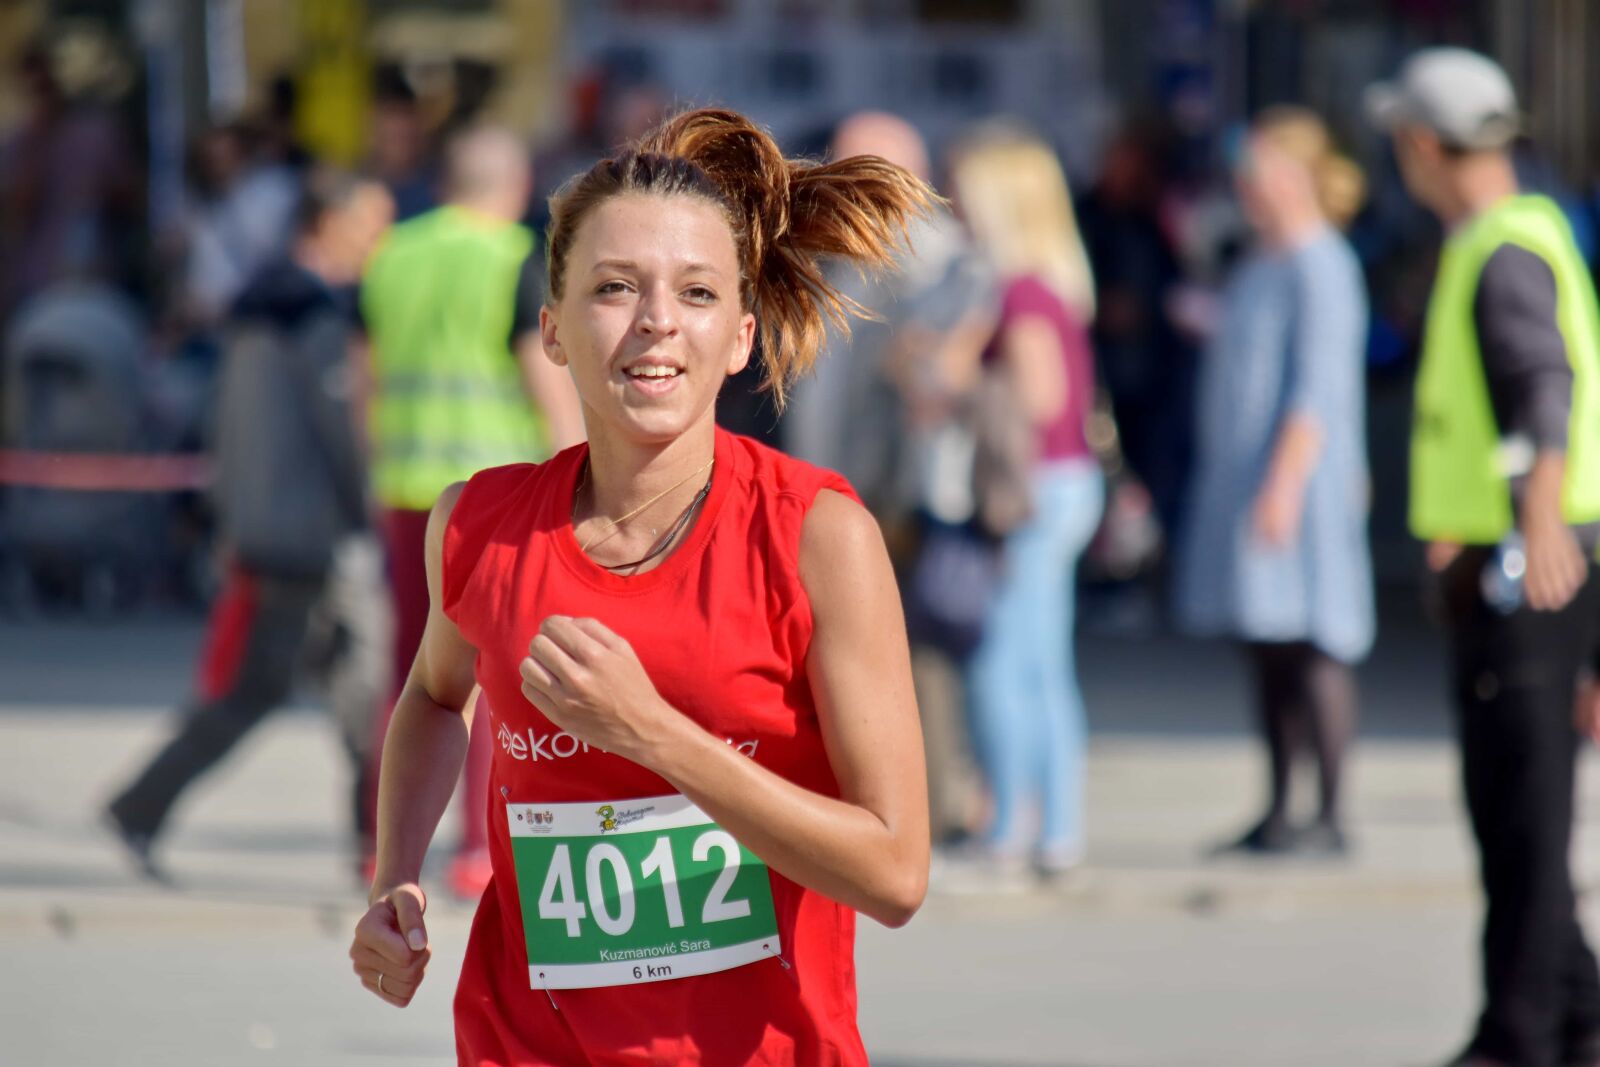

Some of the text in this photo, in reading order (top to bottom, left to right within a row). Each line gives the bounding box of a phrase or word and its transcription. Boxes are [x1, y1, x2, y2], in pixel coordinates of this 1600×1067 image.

[538, 830, 751, 938] 4012
[599, 939, 711, 961] Kuzmanović Sara
[632, 964, 672, 980] 6 km
